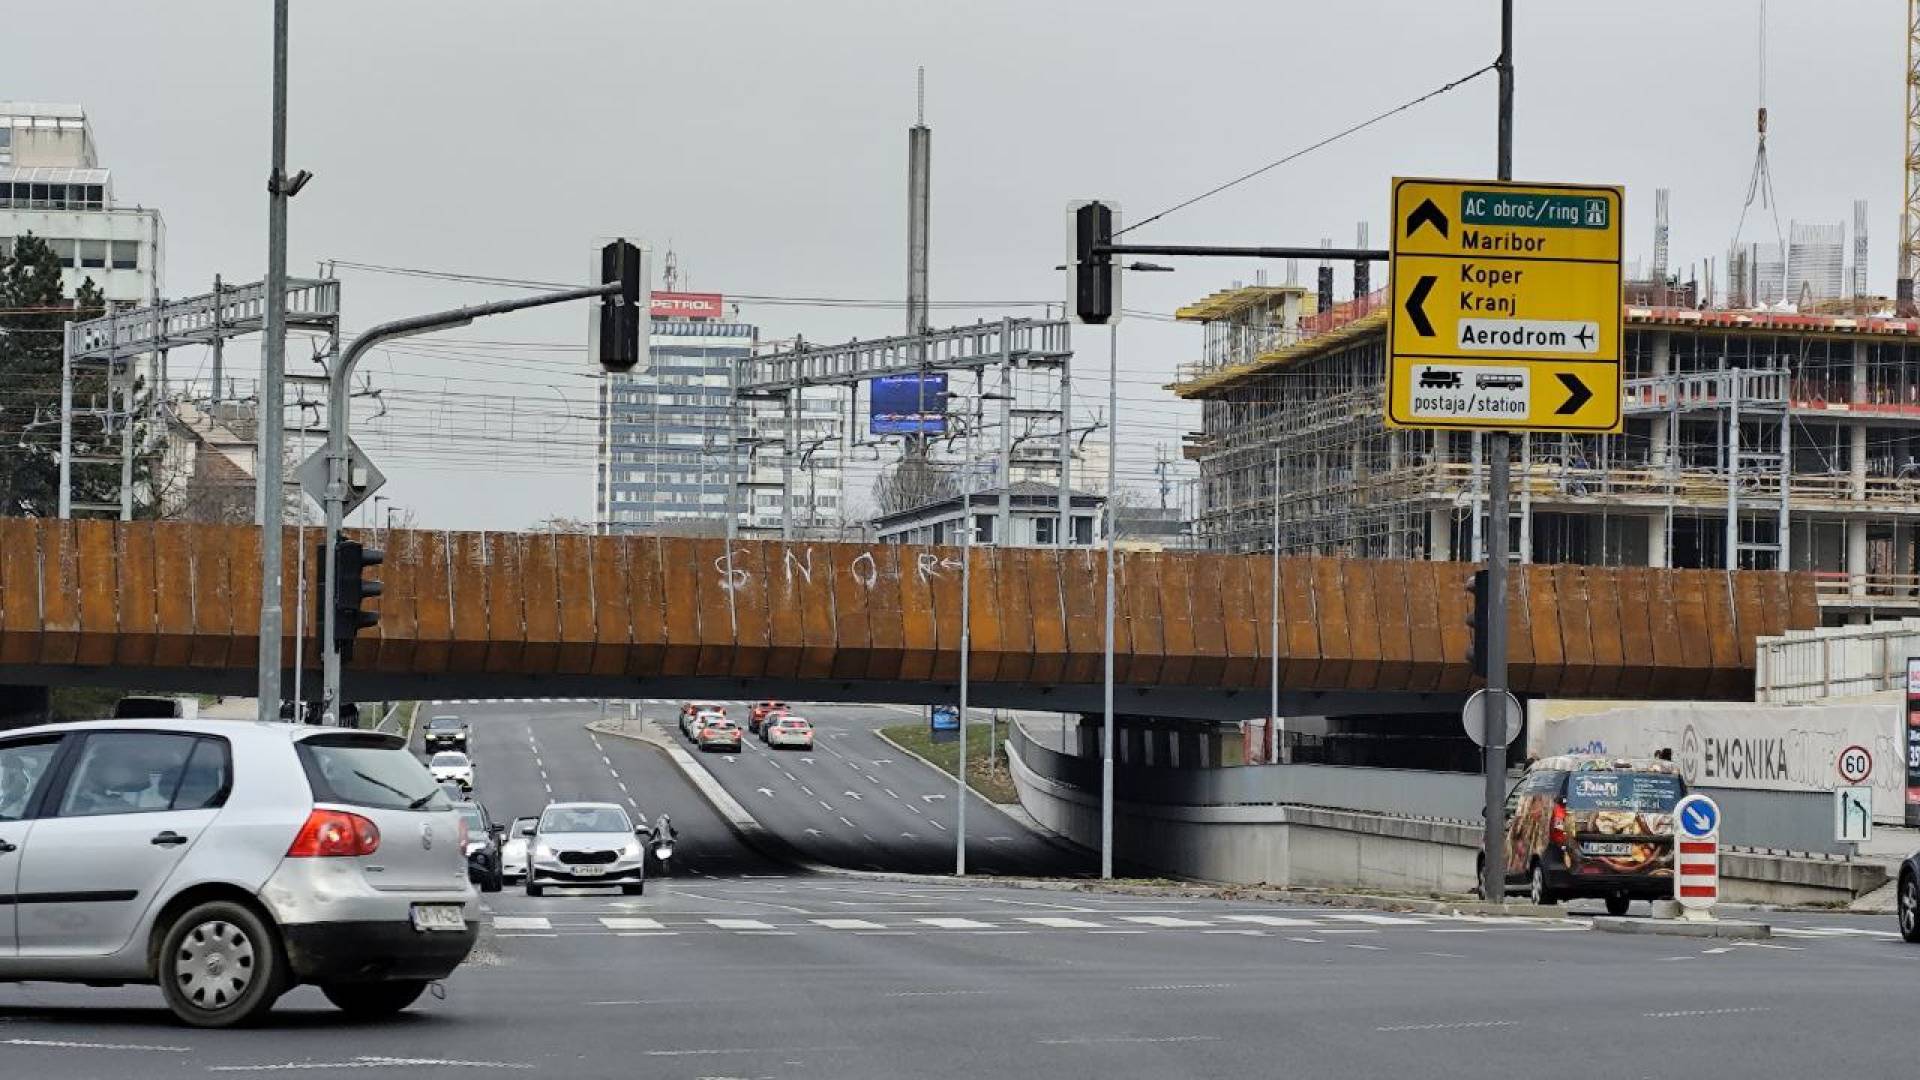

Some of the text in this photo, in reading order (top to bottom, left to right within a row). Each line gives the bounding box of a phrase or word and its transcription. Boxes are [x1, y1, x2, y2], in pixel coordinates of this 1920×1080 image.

[1464, 198, 1579, 224] AC obroč/ring
[1462, 230, 1546, 252] Maribor
[1460, 263, 1523, 287] Koper
[651, 299, 715, 310] PETROL
[1460, 291, 1517, 317] Kranj
[1461, 325, 1566, 346] Aerodrom
[1704, 737, 1789, 781] EMONIKA
[1845, 755, 1866, 773] 60
